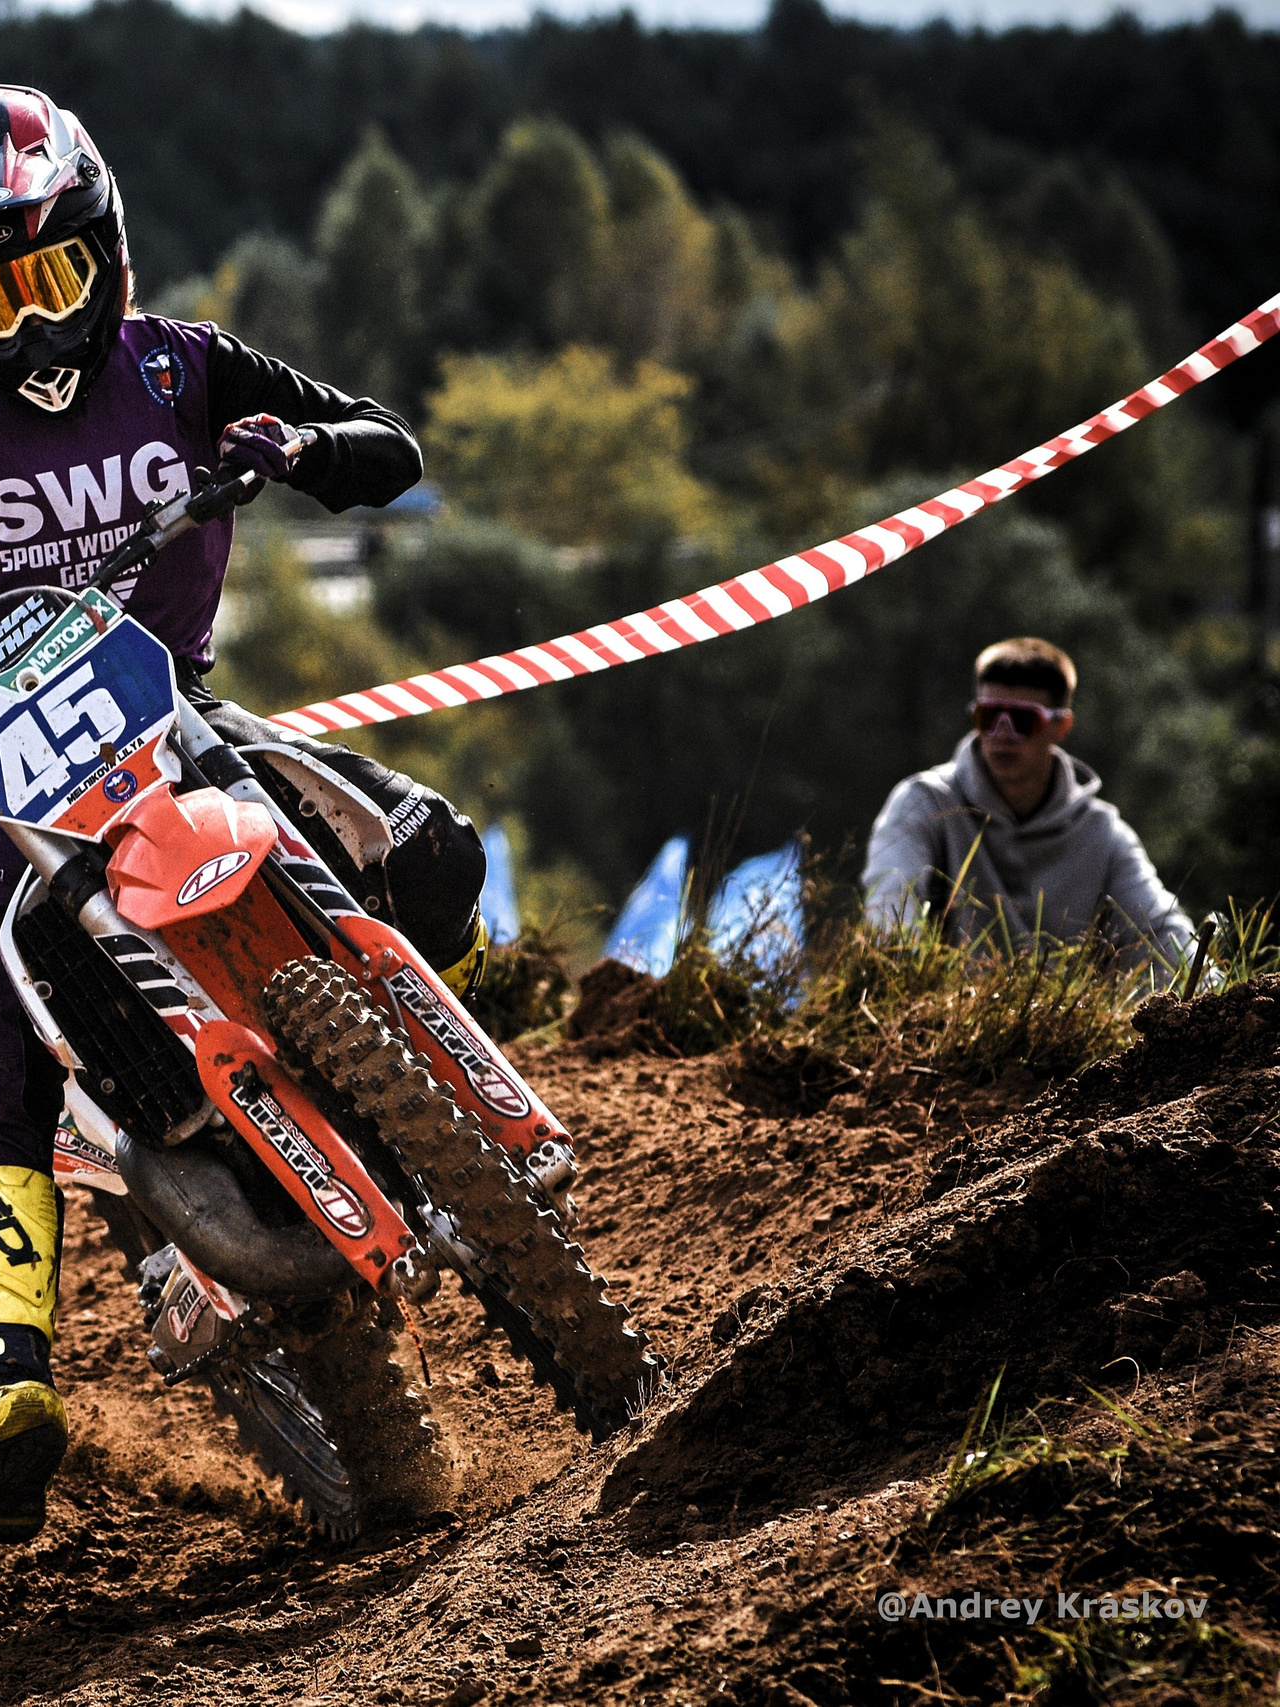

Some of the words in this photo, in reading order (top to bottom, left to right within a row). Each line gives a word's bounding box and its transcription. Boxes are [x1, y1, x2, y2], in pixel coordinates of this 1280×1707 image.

[0, 539, 72, 573] SPORT
[116, 737, 145, 762] LILYA
[387, 786, 423, 827] WORKS
[393, 802, 432, 847] GERMAN
[402, 967, 438, 1002] OILS
[389, 970, 486, 1073] MAXIMA
